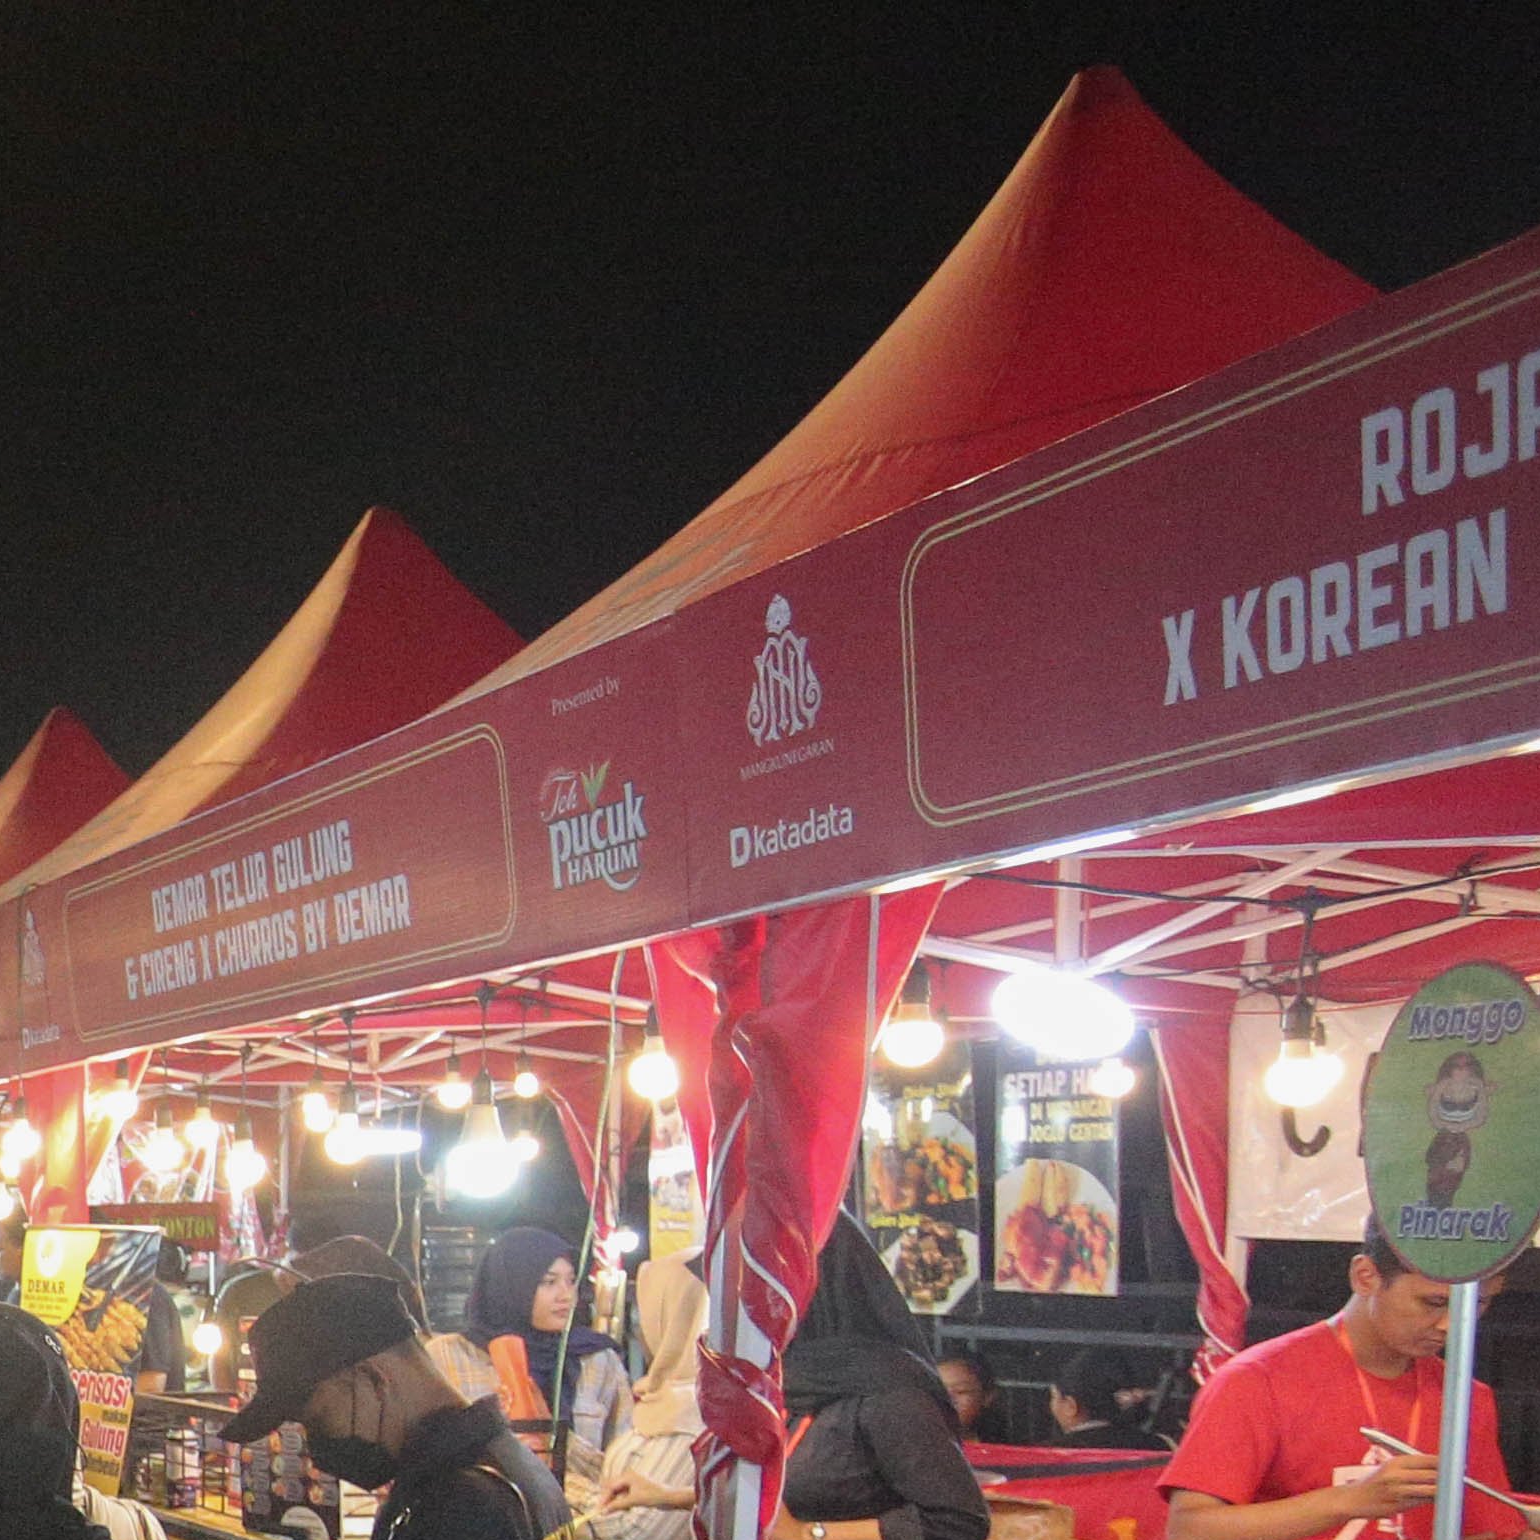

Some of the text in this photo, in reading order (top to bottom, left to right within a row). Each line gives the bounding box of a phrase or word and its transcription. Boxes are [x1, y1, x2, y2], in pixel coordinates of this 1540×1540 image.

[1162, 507, 1508, 707] X KOREAN
[551, 676, 621, 717] Presented by
[548, 780, 648, 890] pucuk
[151, 820, 353, 934] DEMAR TELUR GULUNG
[567, 841, 640, 888] HARUM
[140, 940, 197, 1000] CIRENG
[199, 935, 213, 981] X
[215, 909, 299, 977] CHURROS
[301, 899, 329, 953] BY
[333, 873, 411, 945] DEMAR
[1407, 1000, 1521, 1044] Monggo
[1398, 1202, 1514, 1242] Pinarak
[27, 1279, 66, 1295] DEMAR
